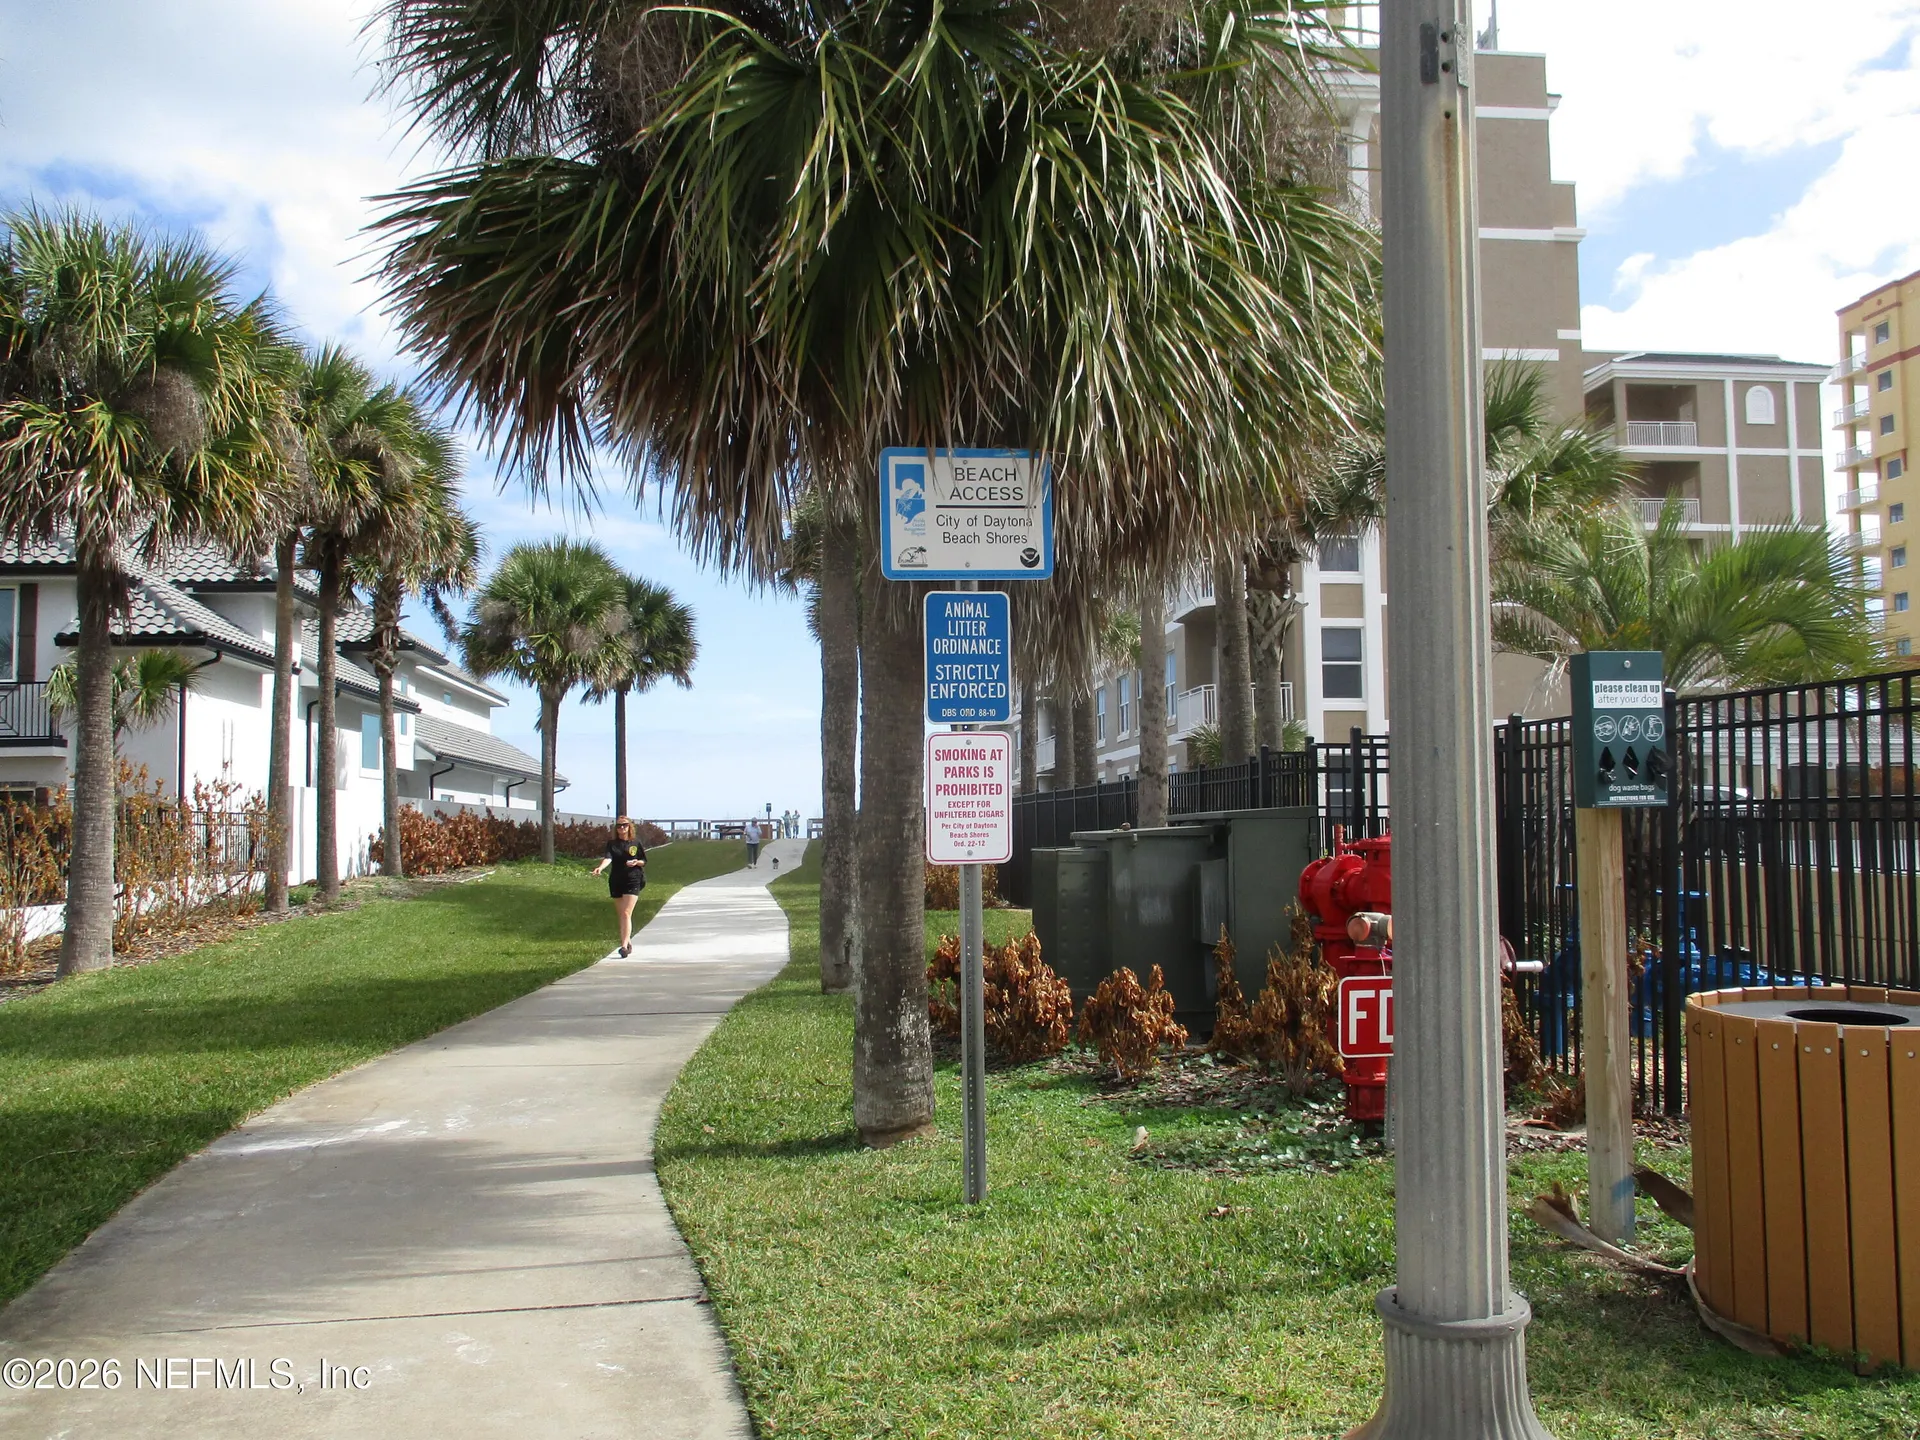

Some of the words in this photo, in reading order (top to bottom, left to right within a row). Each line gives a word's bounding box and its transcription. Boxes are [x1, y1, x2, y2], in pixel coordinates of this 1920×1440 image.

[954, 467, 1017, 482] BEACH
[950, 486, 1024, 501] ACCESS
[936, 514, 960, 530] City
[967, 515, 978, 526] of
[984, 515, 1032, 529] Daytona
[943, 532, 980, 544] Beach
[986, 532, 1027, 544] Shores
[944, 602, 990, 618] ANIMAL
[948, 620, 986, 636] LITTER
[933, 638, 1001, 654] ORDINANCE
[935, 664, 1000, 680] STRICTLY
[930, 682, 1006, 699] ENFORCED
[1595, 683, 1622, 694] please
[1624, 683, 1648, 693] clean
[1650, 685, 1660, 694] up
[1598, 694, 1618, 703] after
[1620, 696, 1639, 705] your
[1641, 694, 1658, 705] dog
[942, 708, 956, 717] DBS
[978, 708, 996, 717] 88-10
[935, 749, 986, 761] SMOKING
[990, 749, 1003, 760] AT
[944, 766, 980, 778] PARKS
[984, 766, 994, 778] IS
[936, 784, 1002, 796] PROHIBITED
[1609, 783, 1621, 793] dog
[1640, 784, 1655, 792] bags
[977, 800, 990, 808] FOR
[935, 811, 976, 819] UNFILTERED
[978, 810, 1004, 818] CIGARS
[974, 822, 997, 830] Daytona
